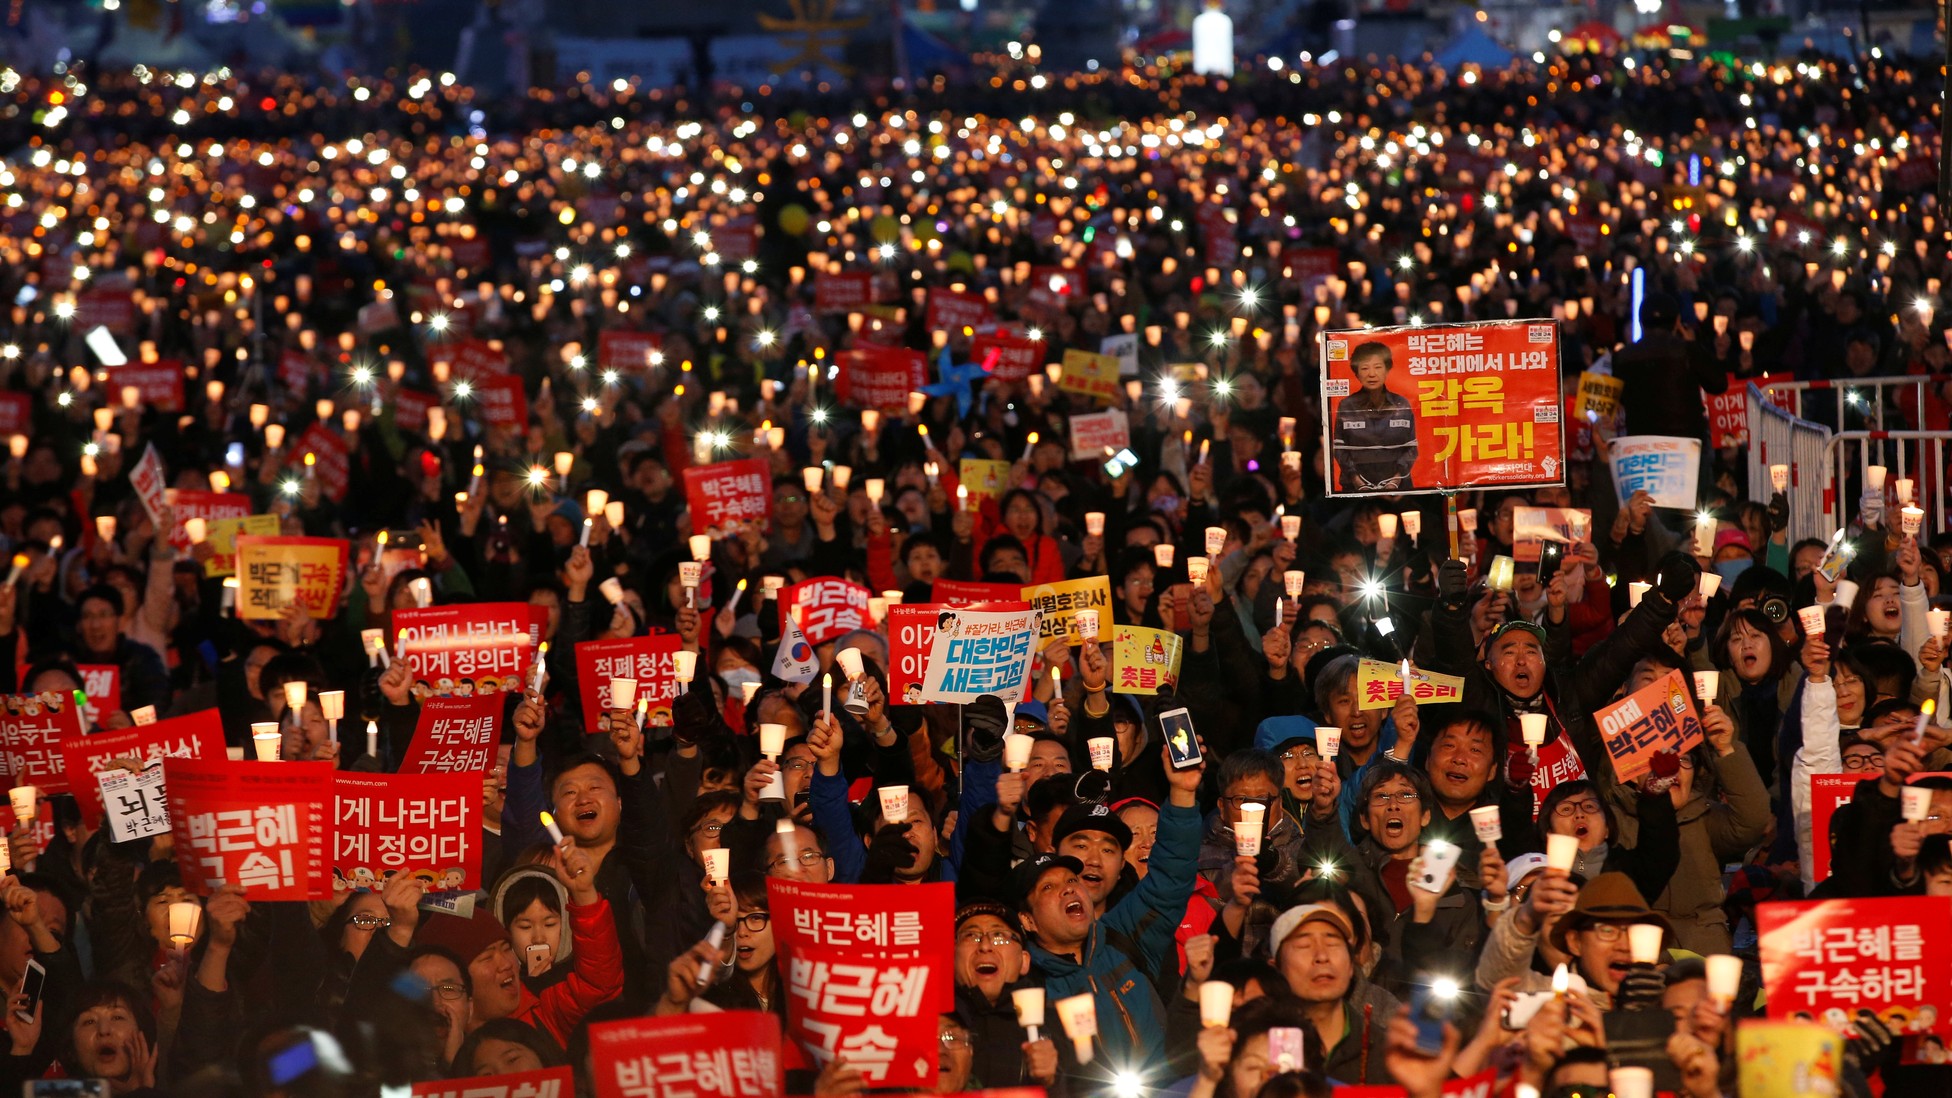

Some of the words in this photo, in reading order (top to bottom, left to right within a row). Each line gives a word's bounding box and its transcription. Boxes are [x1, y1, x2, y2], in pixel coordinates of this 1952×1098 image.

[1407, 333, 1484, 353] 박근혜는
[1408, 352, 1504, 376] 청와대에서
[1509, 350, 1549, 371] 나와
[1417, 376, 1505, 418] 감옥
[1714, 393, 1745, 412] 이게
[1717, 412, 1747, 430] 이게
[1433, 421, 1534, 463] 가라!
[706, 498, 766, 521] 구속하라
[301, 563, 330, 585] 구속
[798, 579, 869, 610] 박근혜
[407, 623, 448, 646] 이게
[454, 618, 521, 644] 나라다
[806, 608, 863, 639] 구속
[1038, 614, 1101, 640] 진상규
[408, 651, 450, 677] 이게
[453, 646, 522, 674] 정의다
[945, 631, 1032, 665] 대한민국
[594, 656, 635, 680] 적폐
[939, 660, 1026, 694] 새로고침
[1121, 665, 1157, 690] 촛불
[1415, 682, 1458, 700] 승리
[0, 718, 61, 746] 구속하
[430, 715, 493, 745] 박근혜를
[1602, 698, 1644, 736] 이제
[1606, 701, 1677, 760] 박근혜
[1662, 716, 1702, 753] 구속
[418, 748, 488, 774] 구속하라
[1552, 751, 1580, 785] 탄핵
[335, 777, 388, 789] www.nanum.com
[378, 796, 470, 829] 나라다
[188, 803, 299, 854] 박근혜
[376, 833, 469, 866] 정의다
[793, 908, 923, 947] 박근혜를
[1794, 924, 1926, 965] 박근혜를
[790, 956, 929, 1018] 박근혜
[1794, 964, 1927, 1007] 구속하라
